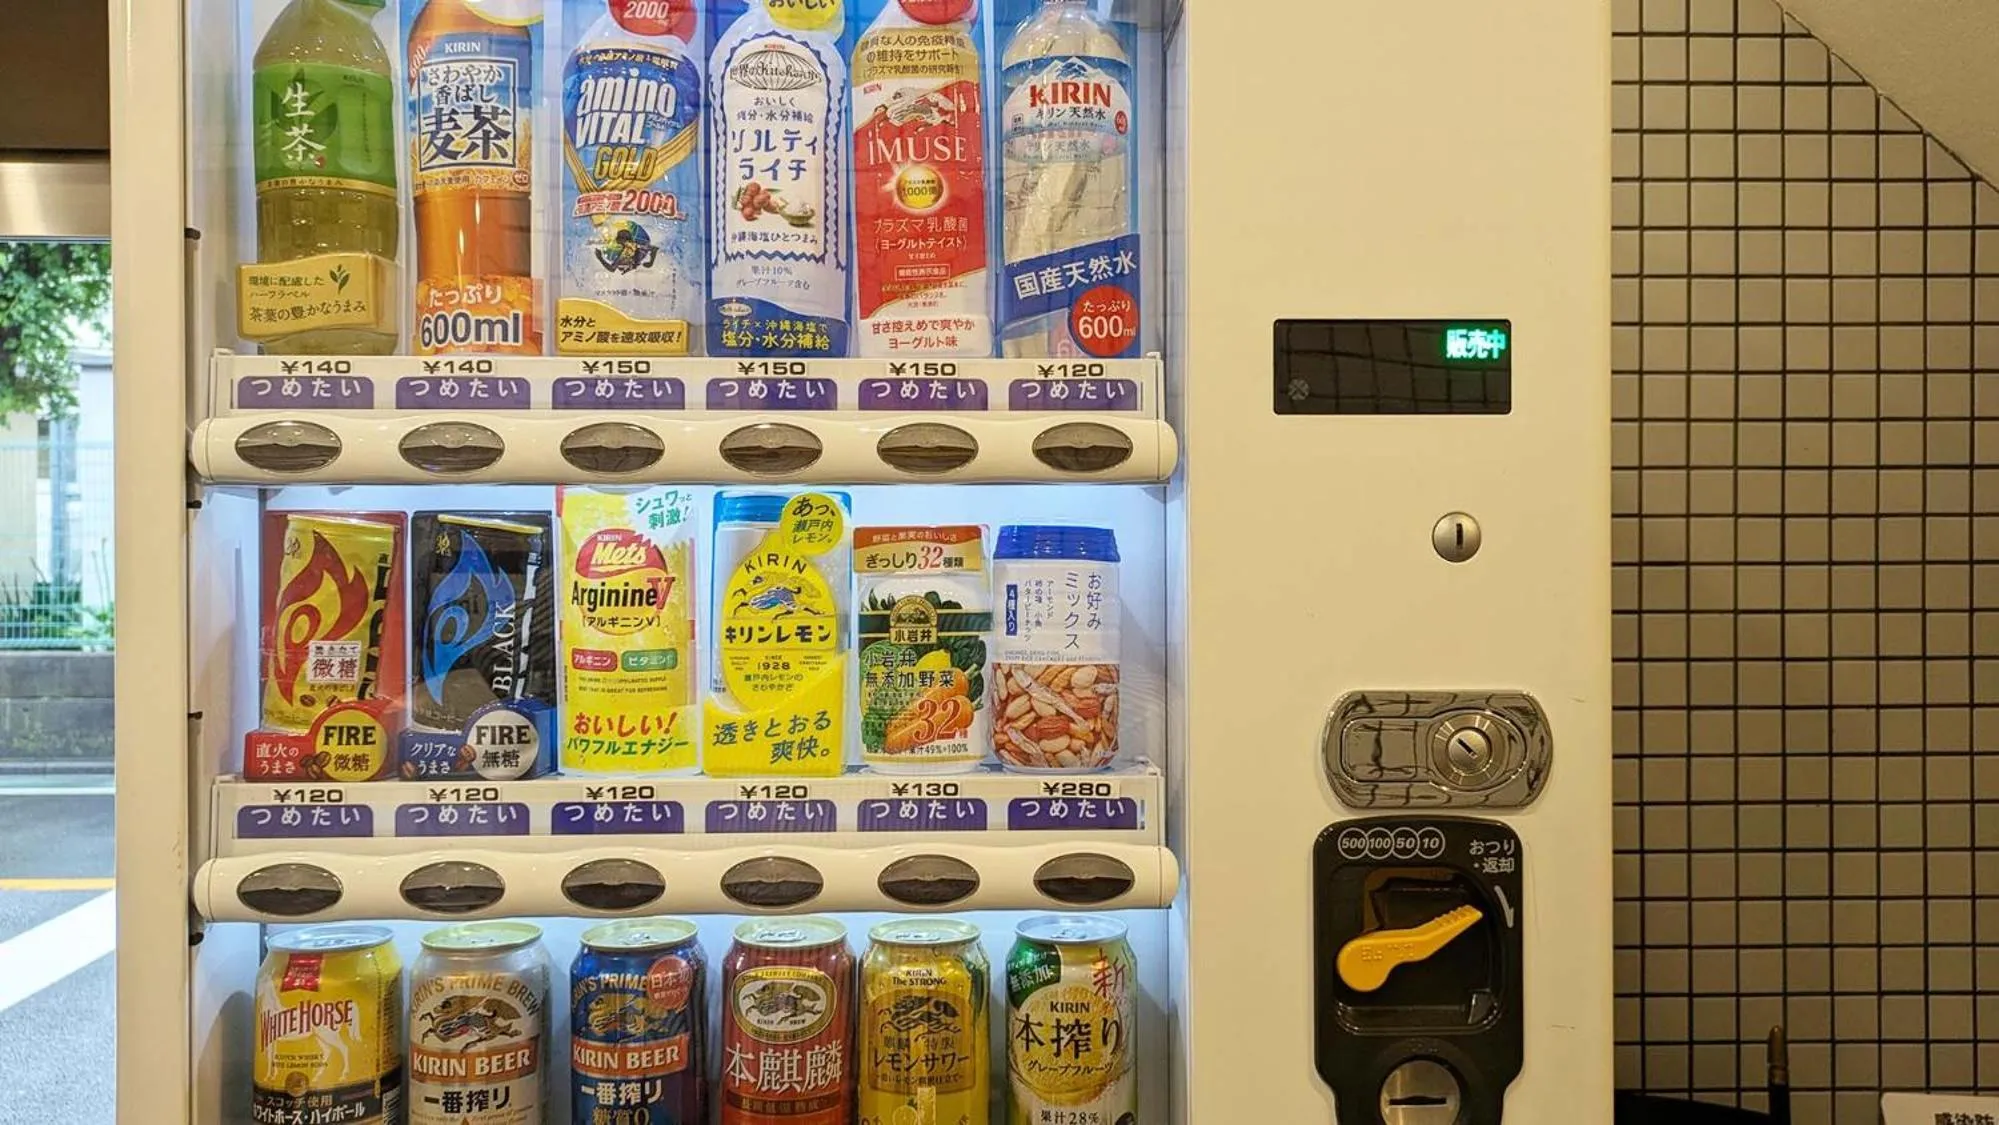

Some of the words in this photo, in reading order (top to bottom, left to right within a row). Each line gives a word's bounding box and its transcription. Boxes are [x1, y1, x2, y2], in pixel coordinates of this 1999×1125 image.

[624, 1, 669, 19] 2000
[445, 41, 480, 53] KIRIN
[866, 48, 959, 63] の維持をサポート
[429, 64, 503, 86] さわやか
[436, 84, 495, 105] 香ばし
[577, 68, 677, 118] amino
[754, 97, 796, 107] おいしく
[1029, 82, 1111, 107] KIRIN
[281, 82, 326, 162] 生茶
[576, 112, 646, 148] VITAL
[422, 105, 511, 163] 麦茶
[731, 129, 818, 155] ソルティ
[594, 146, 657, 181] GOLD
[739, 158, 807, 181] ライチ
[874, 216, 969, 232] プラズマ乳酸菌
[248, 275, 325, 287] 環境に配慮した
[1014, 251, 1137, 299] 国産天然水
[429, 286, 501, 308] たっぷり
[249, 300, 367, 323] 茶葉の豊かなうまみ
[1083, 301, 1131, 313] たっぷり
[420, 311, 521, 348] 600ml
[560, 315, 596, 328] 水分と
[872, 319, 975, 335] 甘さ控えめで爽やか
[721, 331, 830, 350] 塩分・水分補給
[888, 337, 959, 349] ヨーグルト味
[1445, 328, 1506, 359] 販売中
[281, 360, 351, 374] ¥140
[423, 360, 493, 374] ¥140
[582, 360, 651, 374] ¥150
[738, 362, 806, 375] ¥150
[890, 363, 957, 376] ¥150
[1038, 363, 1104, 378] ¥120
[251, 378, 361, 398] つめたい
[409, 378, 518, 398] つめたい
[565, 379, 673, 398] つめたい
[719, 380, 825, 399] つめたい
[871, 380, 976, 400] つめたい
[1021, 380, 1125, 400] つめたい
[793, 519, 834, 534] 瀬戸内
[591, 541, 648, 566] Mets
[744, 553, 807, 574] KIRIN
[1087, 571, 1102, 630] お好み
[1064, 572, 1081, 650] ミックス
[725, 625, 831, 644] キリンレモン
[894, 629, 932, 642] 小岩井
[492, 602, 515, 694] BLACK
[312, 658, 358, 678] 微糖
[757, 661, 791, 671] 1928
[865, 649, 917, 668] 小岩井
[866, 671, 955, 689] 無添加野菜
[713, 710, 832, 747] 透きとおる
[912, 698, 961, 742] 32
[323, 726, 376, 747] FIRE
[475, 724, 531, 745] FIRE
[256, 743, 300, 759] 直火の
[411, 743, 457, 758] クリアな
[567, 737, 689, 756] パワフルエナジー
[260, 761, 297, 775] うまさ
[334, 753, 371, 772] 微糖
[418, 761, 450, 774] うまさ
[482, 750, 521, 768] 無糖
[274, 788, 343, 803] ¥120
[430, 787, 499, 802] ¥120
[586, 786, 655, 800] ¥120
[740, 785, 808, 799] ¥120
[892, 783, 959, 797] ¥130
[1043, 782, 1111, 796] ¥280
[251, 806, 361, 826] つめたい
[408, 804, 517, 825] つめたい
[564, 803, 671, 822] つめたい
[719, 802, 823, 821] つめたい
[871, 800, 975, 820] つめたい
[1021, 799, 1125, 819] つめたい
[1342, 837, 1366, 849] 500
[1370, 837, 1391, 849] 100
[1396, 837, 1416, 849] 50
[1423, 837, 1440, 849] 10
[1469, 839, 1515, 855] おつり
[600, 973, 649, 990] PRIME
[1091, 948, 1125, 999] 新
[450, 974, 505, 991] PRIME
[507, 980, 541, 1016] BREW
[1050, 1001, 1091, 1013] KIRIN
[260, 1008, 297, 1053] WHITE
[300, 1000, 353, 1034] HORSE
[1015, 1013, 1122, 1060] 本搾り
[413, 1052, 466, 1077] KIRIN
[475, 1049, 530, 1076] BEER
[573, 1043, 619, 1070] KIRIN
[626, 1045, 680, 1070] BEER
[874, 1049, 970, 1073] レモンサワー
[724, 1039, 842, 1095] 本麒麟
[1028, 1059, 1113, 1076] グレープフルーツ
[424, 1086, 510, 1114] 一番搾り
[581, 1079, 662, 1105] 一番搾り
